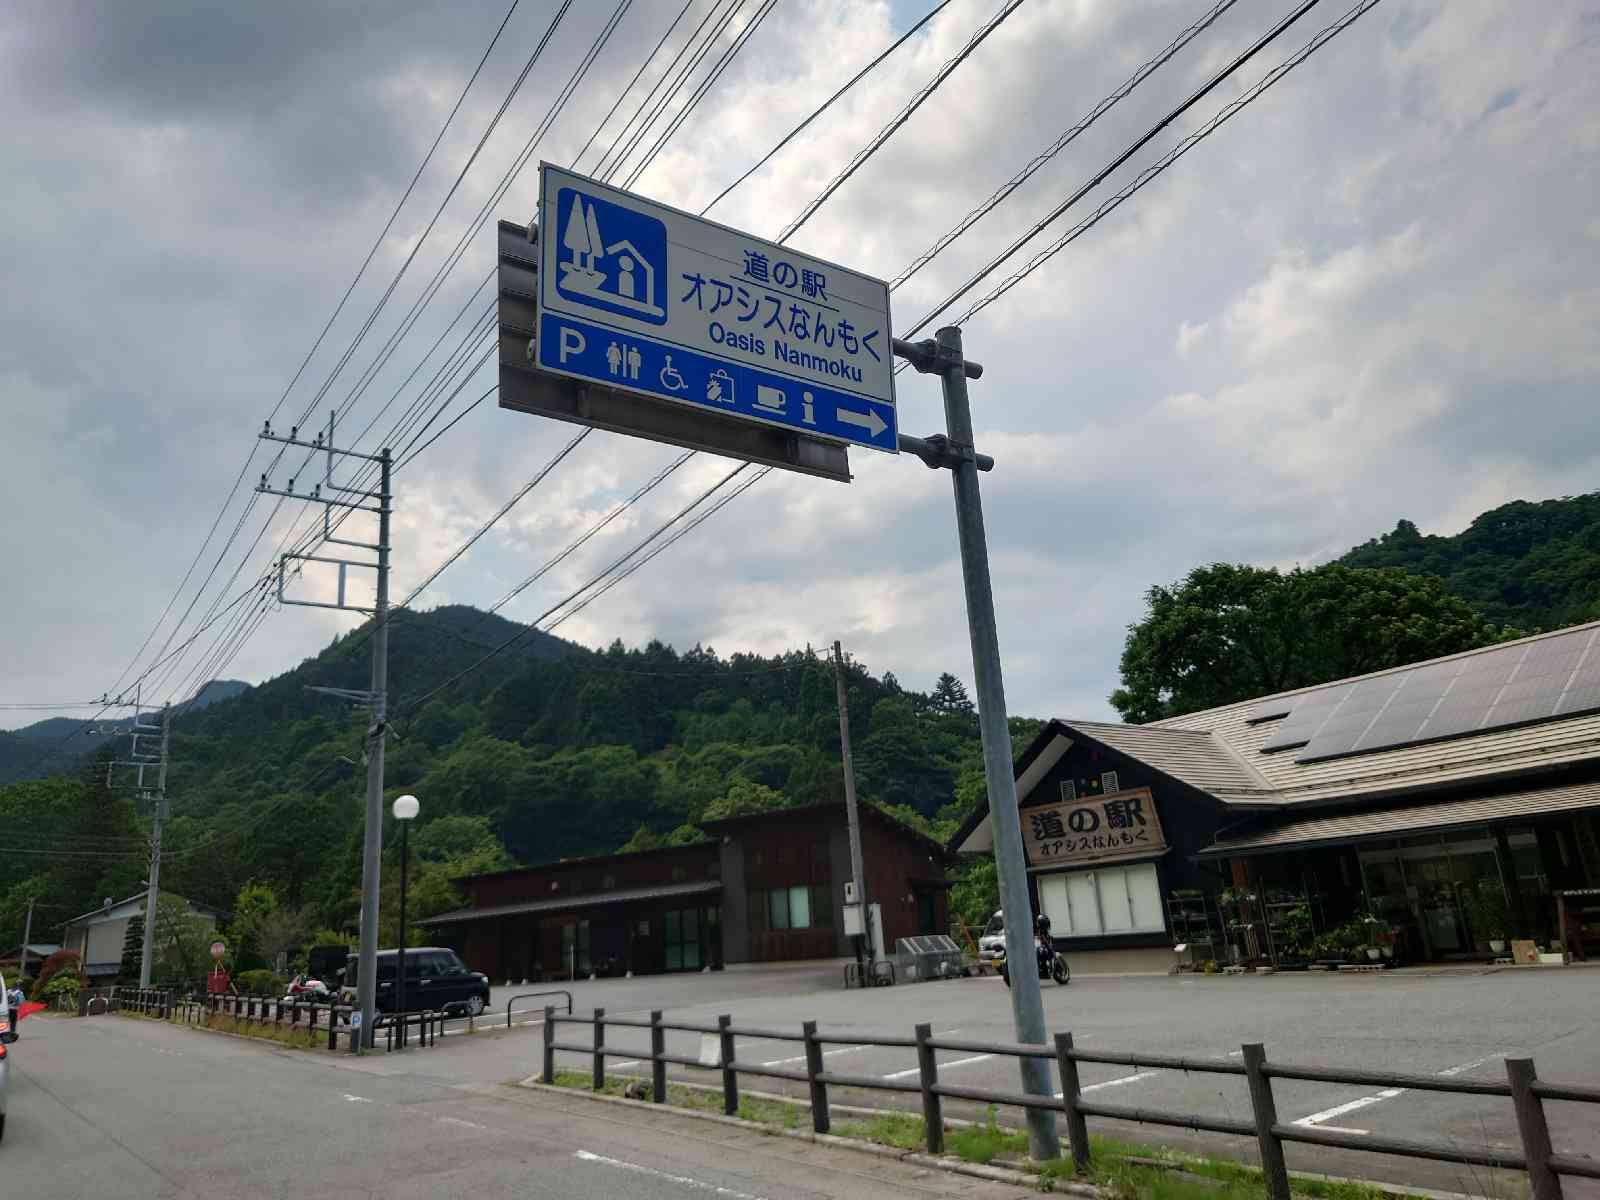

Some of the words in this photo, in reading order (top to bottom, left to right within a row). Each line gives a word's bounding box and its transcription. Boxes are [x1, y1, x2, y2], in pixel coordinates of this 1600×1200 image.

[744, 250, 828, 301] 道の駅
[681, 273, 880, 362] オアシスなんもく
[559, 327, 586, 364] P
[709, 321, 765, 355] Oasis
[774, 340, 863, 382] Nanmoku
[1030, 798, 1146, 840] 道の駅
[1040, 830, 1148, 855] オアシスなんもく
